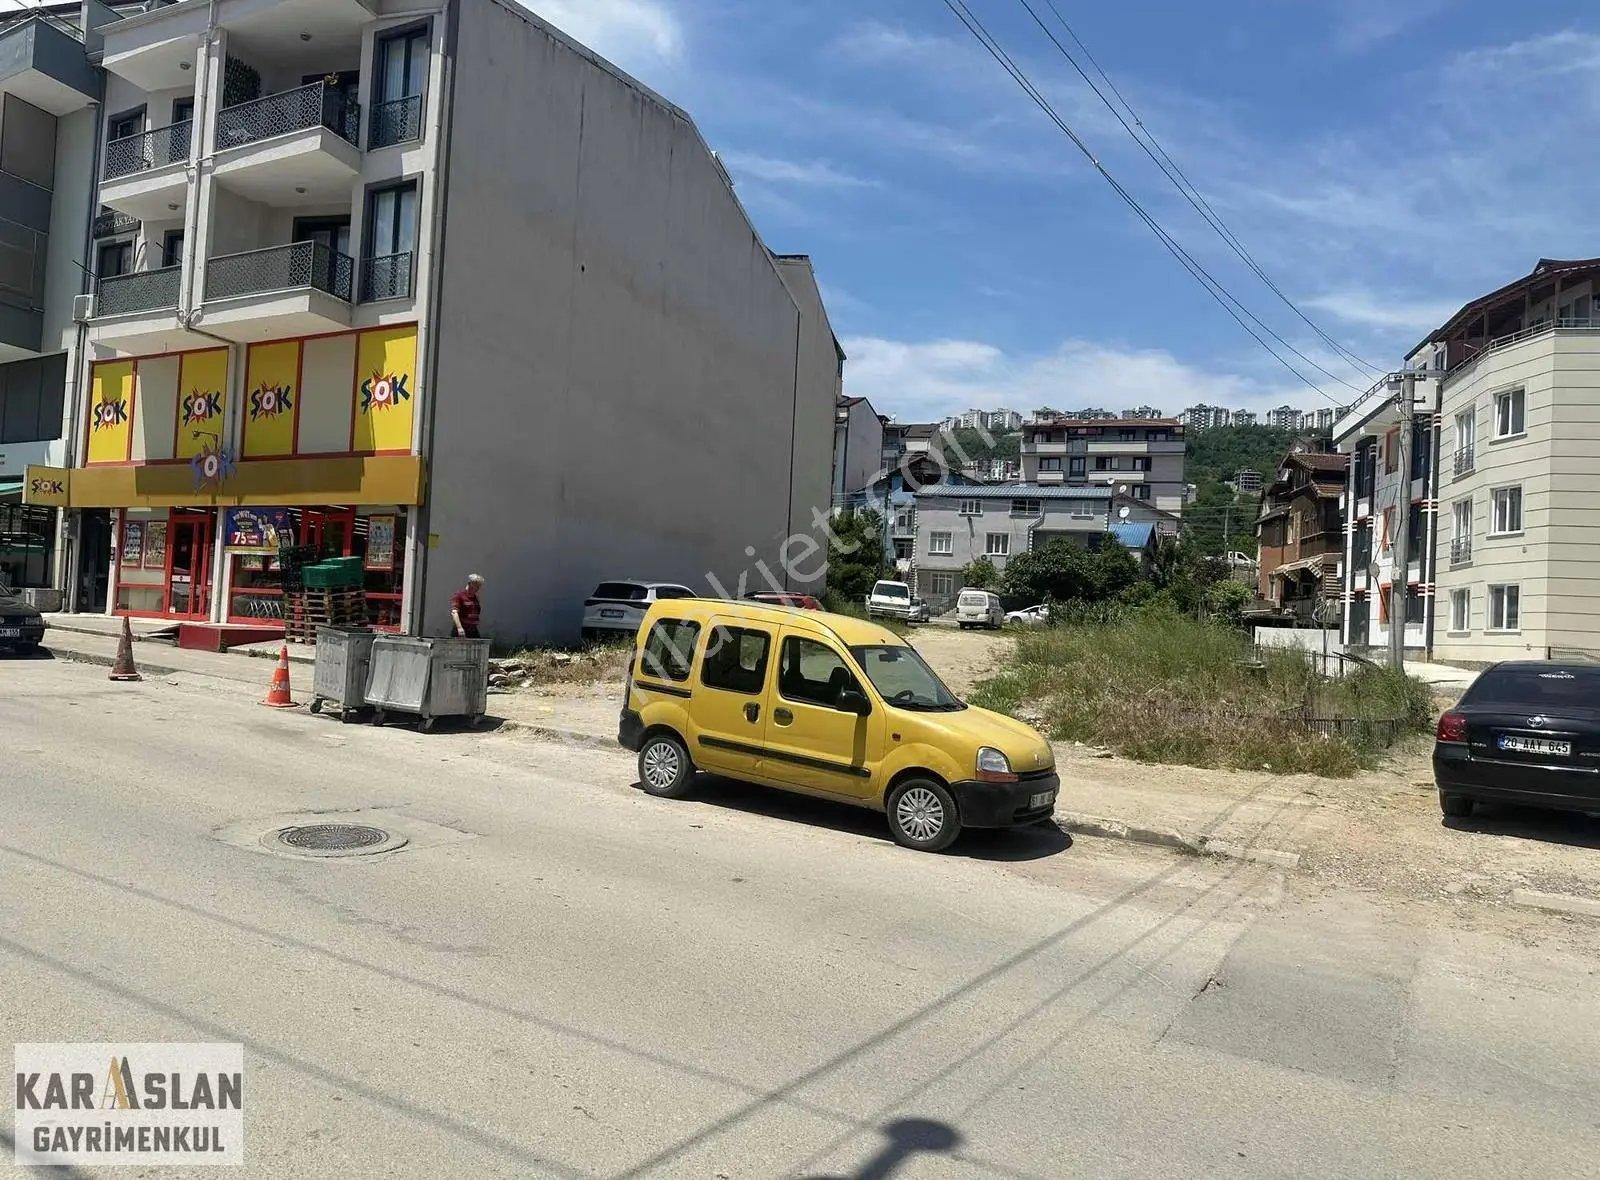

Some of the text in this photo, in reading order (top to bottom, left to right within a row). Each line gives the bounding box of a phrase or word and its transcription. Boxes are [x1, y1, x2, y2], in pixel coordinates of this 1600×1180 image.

[233, 531, 247, 545] 75
[1504, 737, 1568, 753] 20 AAY 645
